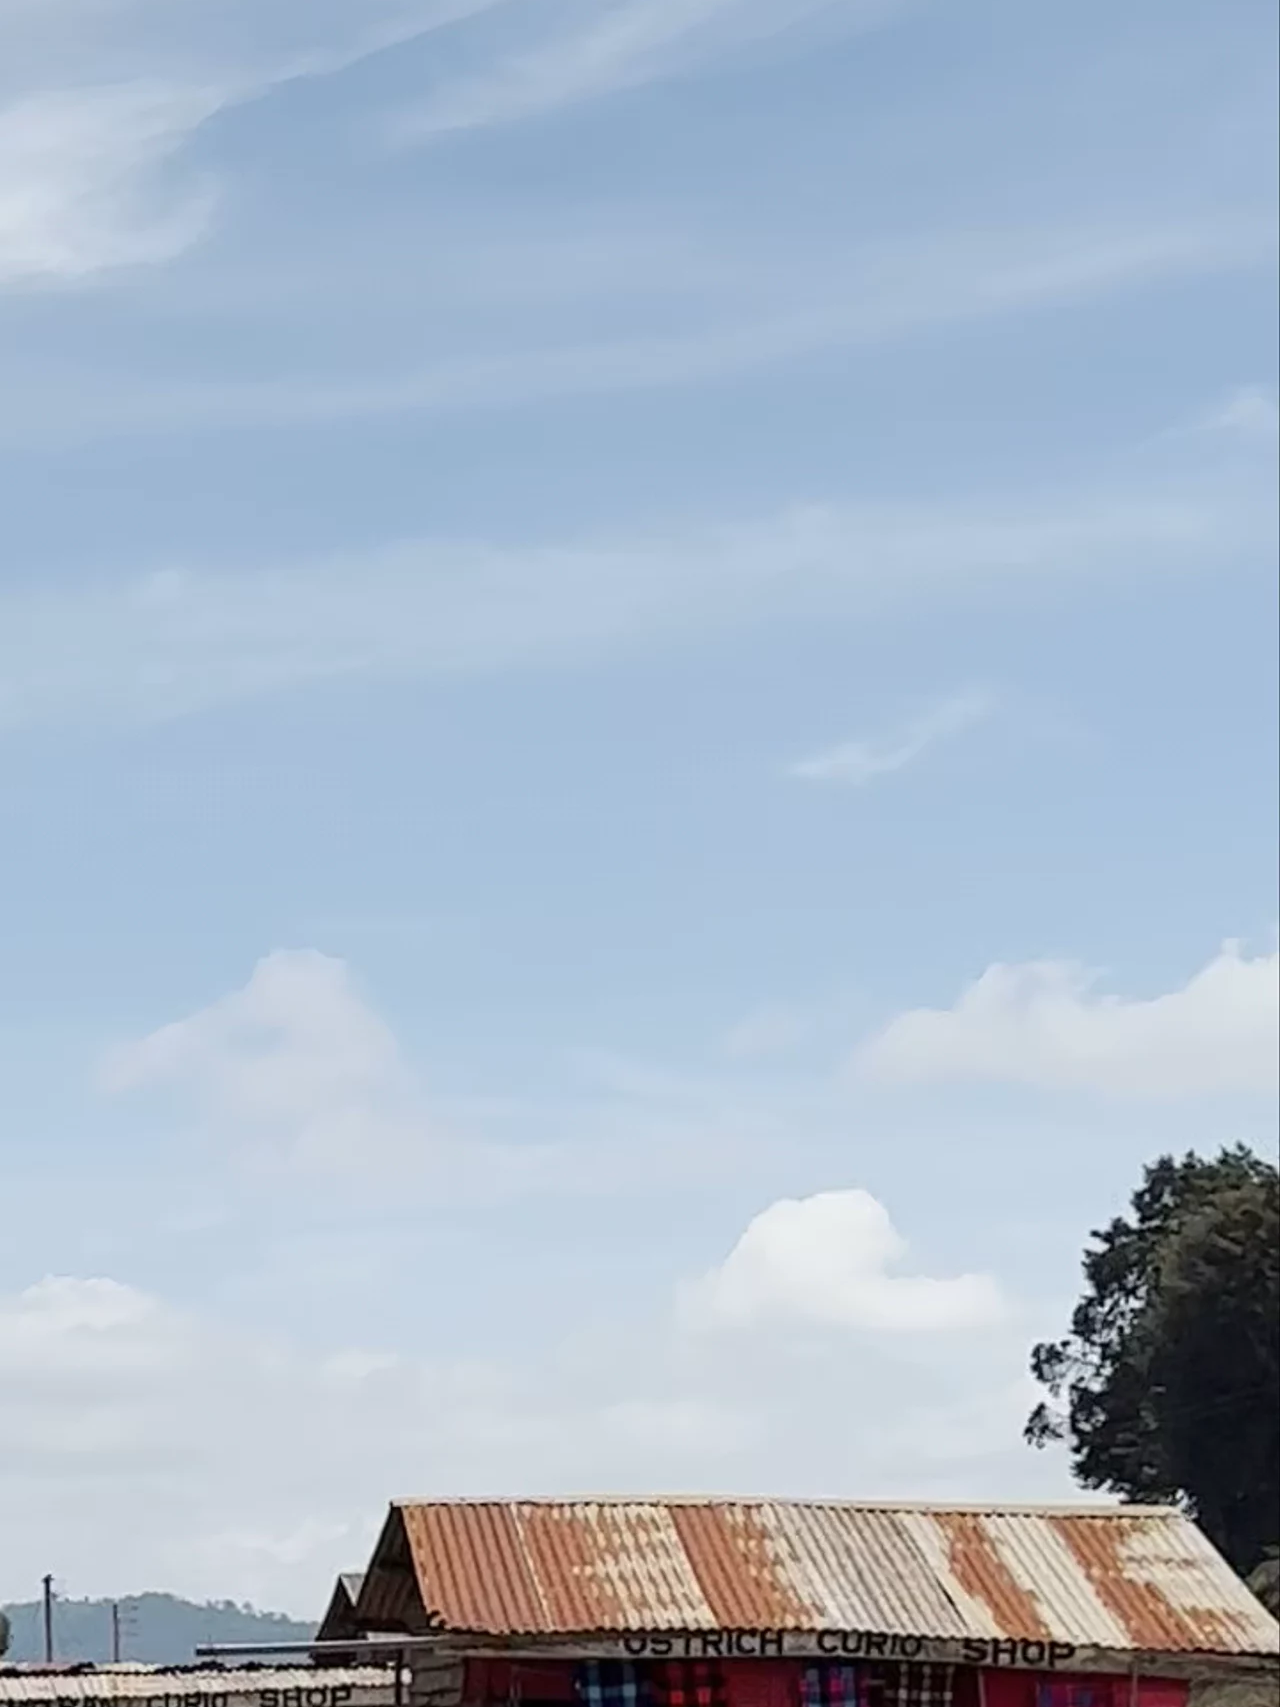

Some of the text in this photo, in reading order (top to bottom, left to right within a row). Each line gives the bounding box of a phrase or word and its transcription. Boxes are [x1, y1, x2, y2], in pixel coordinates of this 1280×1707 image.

[623, 1629, 1076, 1667] OSTRICH CURIO SHOP
